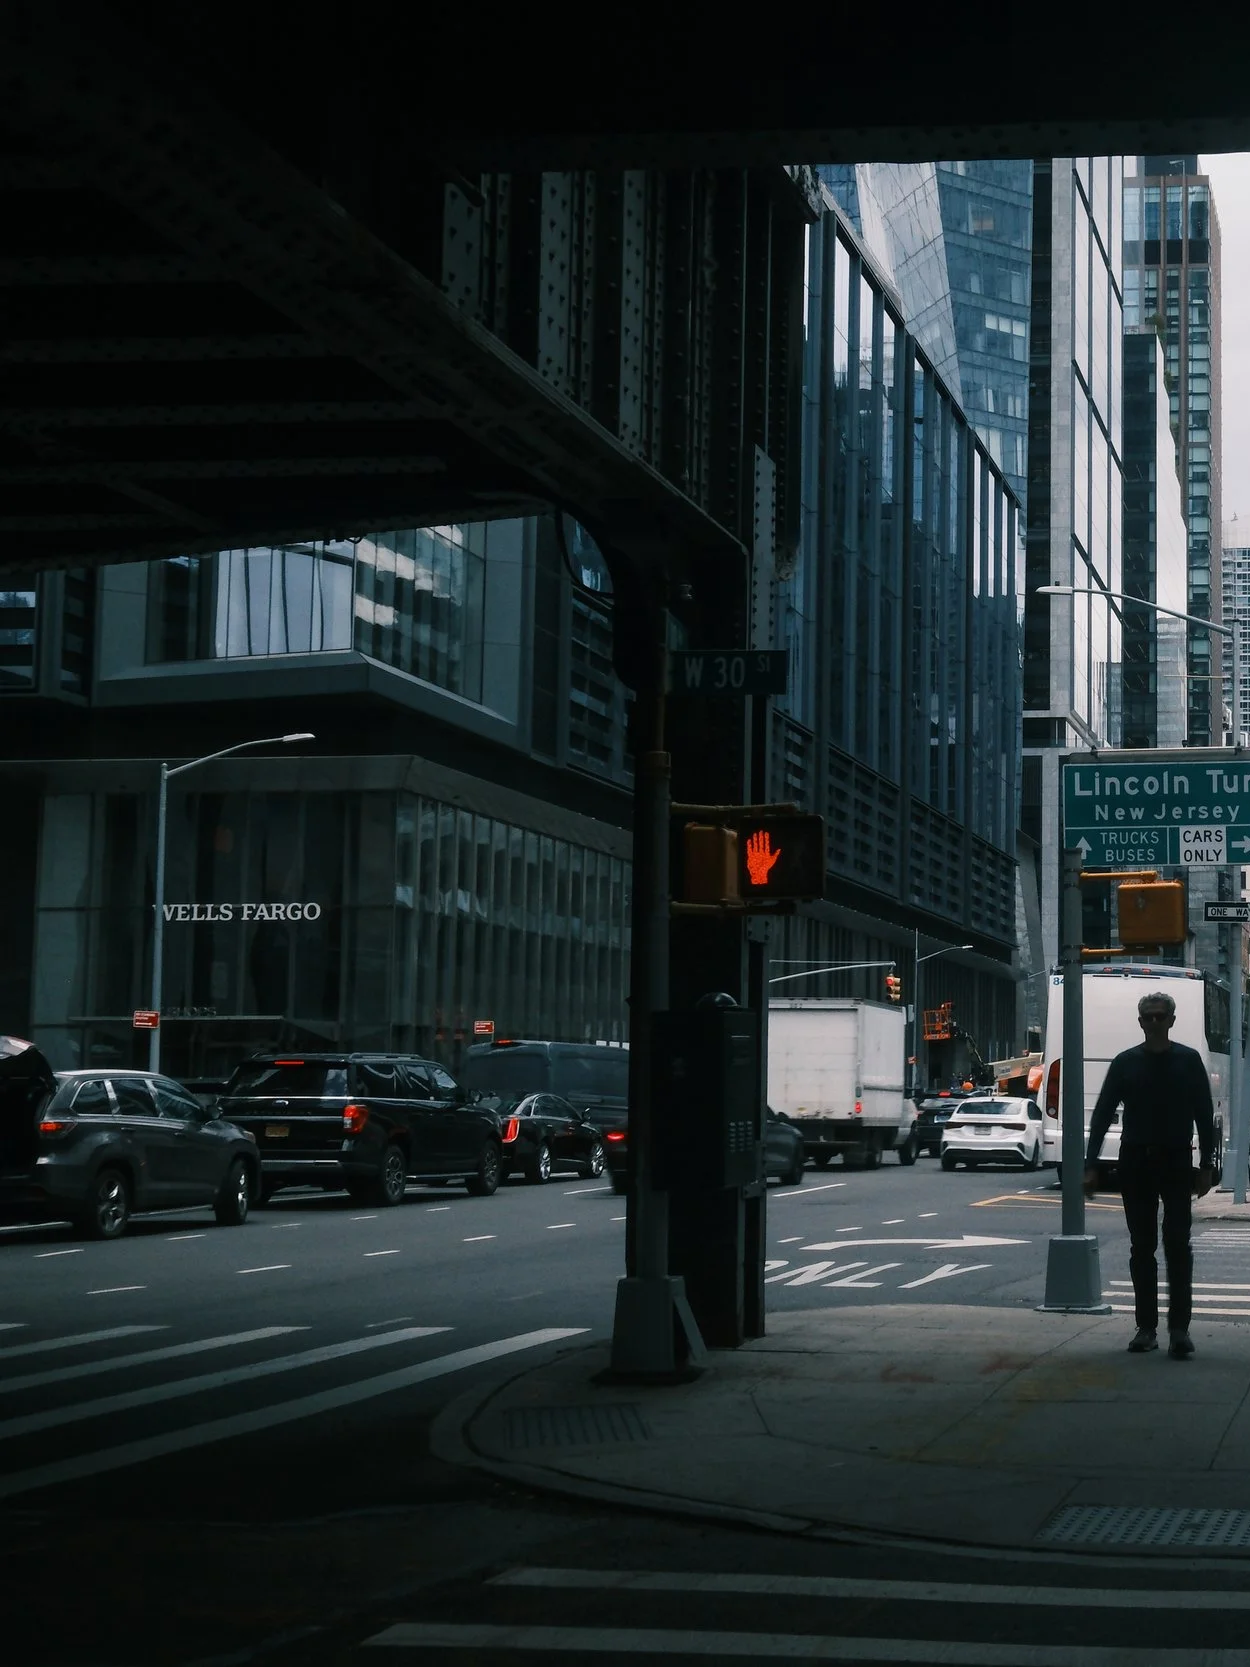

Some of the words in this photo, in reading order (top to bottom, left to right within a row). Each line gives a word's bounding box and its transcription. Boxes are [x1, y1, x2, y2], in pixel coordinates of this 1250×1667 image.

[684, 656, 704, 688] W
[713, 656, 746, 688] 30
[1074, 770, 1190, 796] Lincoln
[1095, 804, 1145, 821] New
[1153, 803, 1240, 822] Jersey
[1100, 831, 1160, 845] TRUCKS
[1183, 830, 1224, 843] CARS
[1105, 849, 1156, 862] BUSES
[1183, 849, 1223, 862] ONLY
[241, 902, 321, 921] FARGO
[1210, 907, 1228, 916] ONE
[1235, 908, 1249, 916] WA
